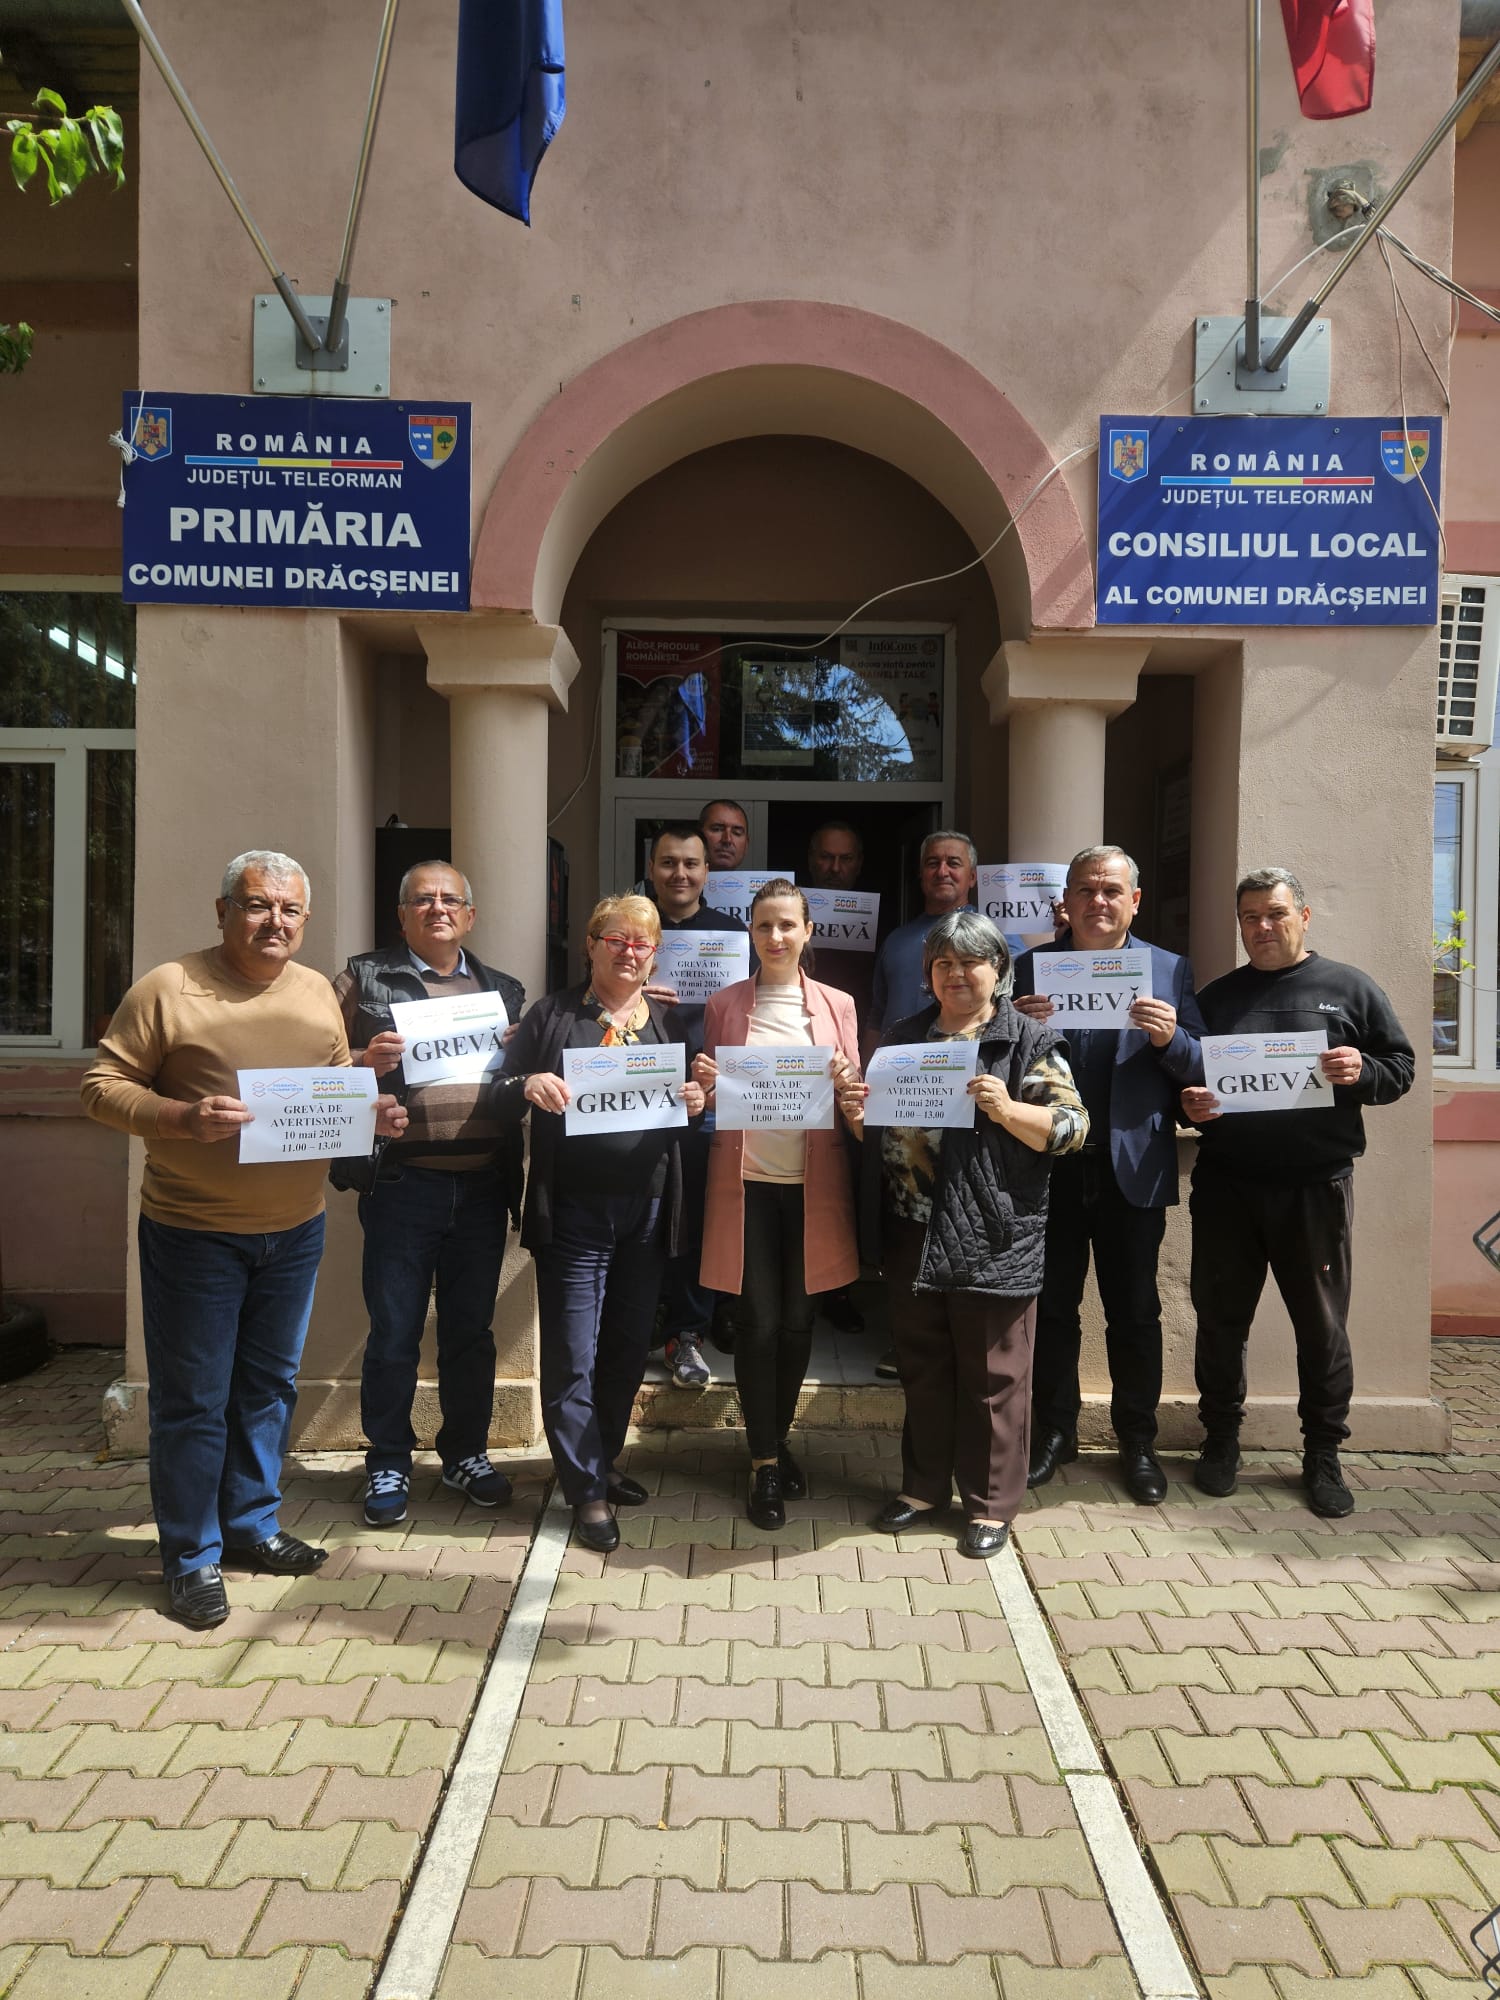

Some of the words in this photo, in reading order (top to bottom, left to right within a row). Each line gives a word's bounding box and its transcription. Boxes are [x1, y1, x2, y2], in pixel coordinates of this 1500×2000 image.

[216, 432, 372, 455] ROMÂNIA
[1191, 450, 1344, 472] ROMÂNIA
[187, 469, 276, 490] JUDEȚUL
[282, 471, 402, 489] TELEORMAN
[1162, 489, 1249, 509] JUDEȚUL
[1254, 489, 1373, 505] TELEORMAN
[170, 502, 422, 548] PRIMĂRIA
[1108, 532, 1298, 558] CONSILIUL
[1310, 532, 1427, 557] LOCAL
[128, 563, 273, 589] COMUNEI
[285, 563, 459, 598] DRĂCȘENEI
[1105, 586, 1138, 605] AL
[1146, 586, 1267, 606] COMUNEI
[1277, 583, 1427, 612] DRĂCȘENEI
[869, 640, 918, 651] InfoCons
[1020, 872, 1045, 882] SCOR
[834, 898, 858, 908] SCOR
[812, 921, 870, 940] REVĂ
[699, 942, 724, 951] SCOR
[677, 960, 708, 968] GREVĂ
[1092, 960, 1122, 971] SCOR
[669, 970, 730, 978] AVERTISMENT
[412, 1025, 503, 1062] GREVĂ
[1264, 1042, 1297, 1053] SCOR
[626, 1056, 657, 1068] SCOR
[776, 1059, 805, 1069] SCOR
[922, 1055, 949, 1065] SCOR
[751, 1080, 787, 1089] GREVĂ
[788, 1080, 802, 1089] DE
[896, 1074, 930, 1084] GREVĂ
[931, 1076, 945, 1084] DE
[1217, 1065, 1323, 1095] GREVĂ
[312, 1080, 345, 1092] SCOR
[886, 1087, 955, 1096] AVERTISMENT
[576, 1081, 677, 1114] GREVĂ
[741, 1091, 813, 1100] AVERTISMENT
[284, 1103, 325, 1114] GREVĂ
[328, 1104, 343, 1114] DE
[753, 1103, 762, 1111] 10
[764, 1103, 780, 1111] mai
[782, 1103, 801, 1111] 2024
[897, 1099, 906, 1107] 10
[908, 1099, 923, 1107] mai
[925, 1099, 943, 1107] 2024
[751, 1114, 772, 1122] 11.00
[782, 1114, 804, 1122] 13.00
[895, 1110, 915, 1119] 11.00
[924, 1111, 945, 1119] 13.00
[270, 1116, 355, 1128] AVERTISMENT
[284, 1131, 296, 1140] 10
[298, 1130, 317, 1139] mai
[319, 1129, 341, 1138] 2024
[282, 1143, 307, 1153] 11.00
[318, 1141, 342, 1151] 13.00
